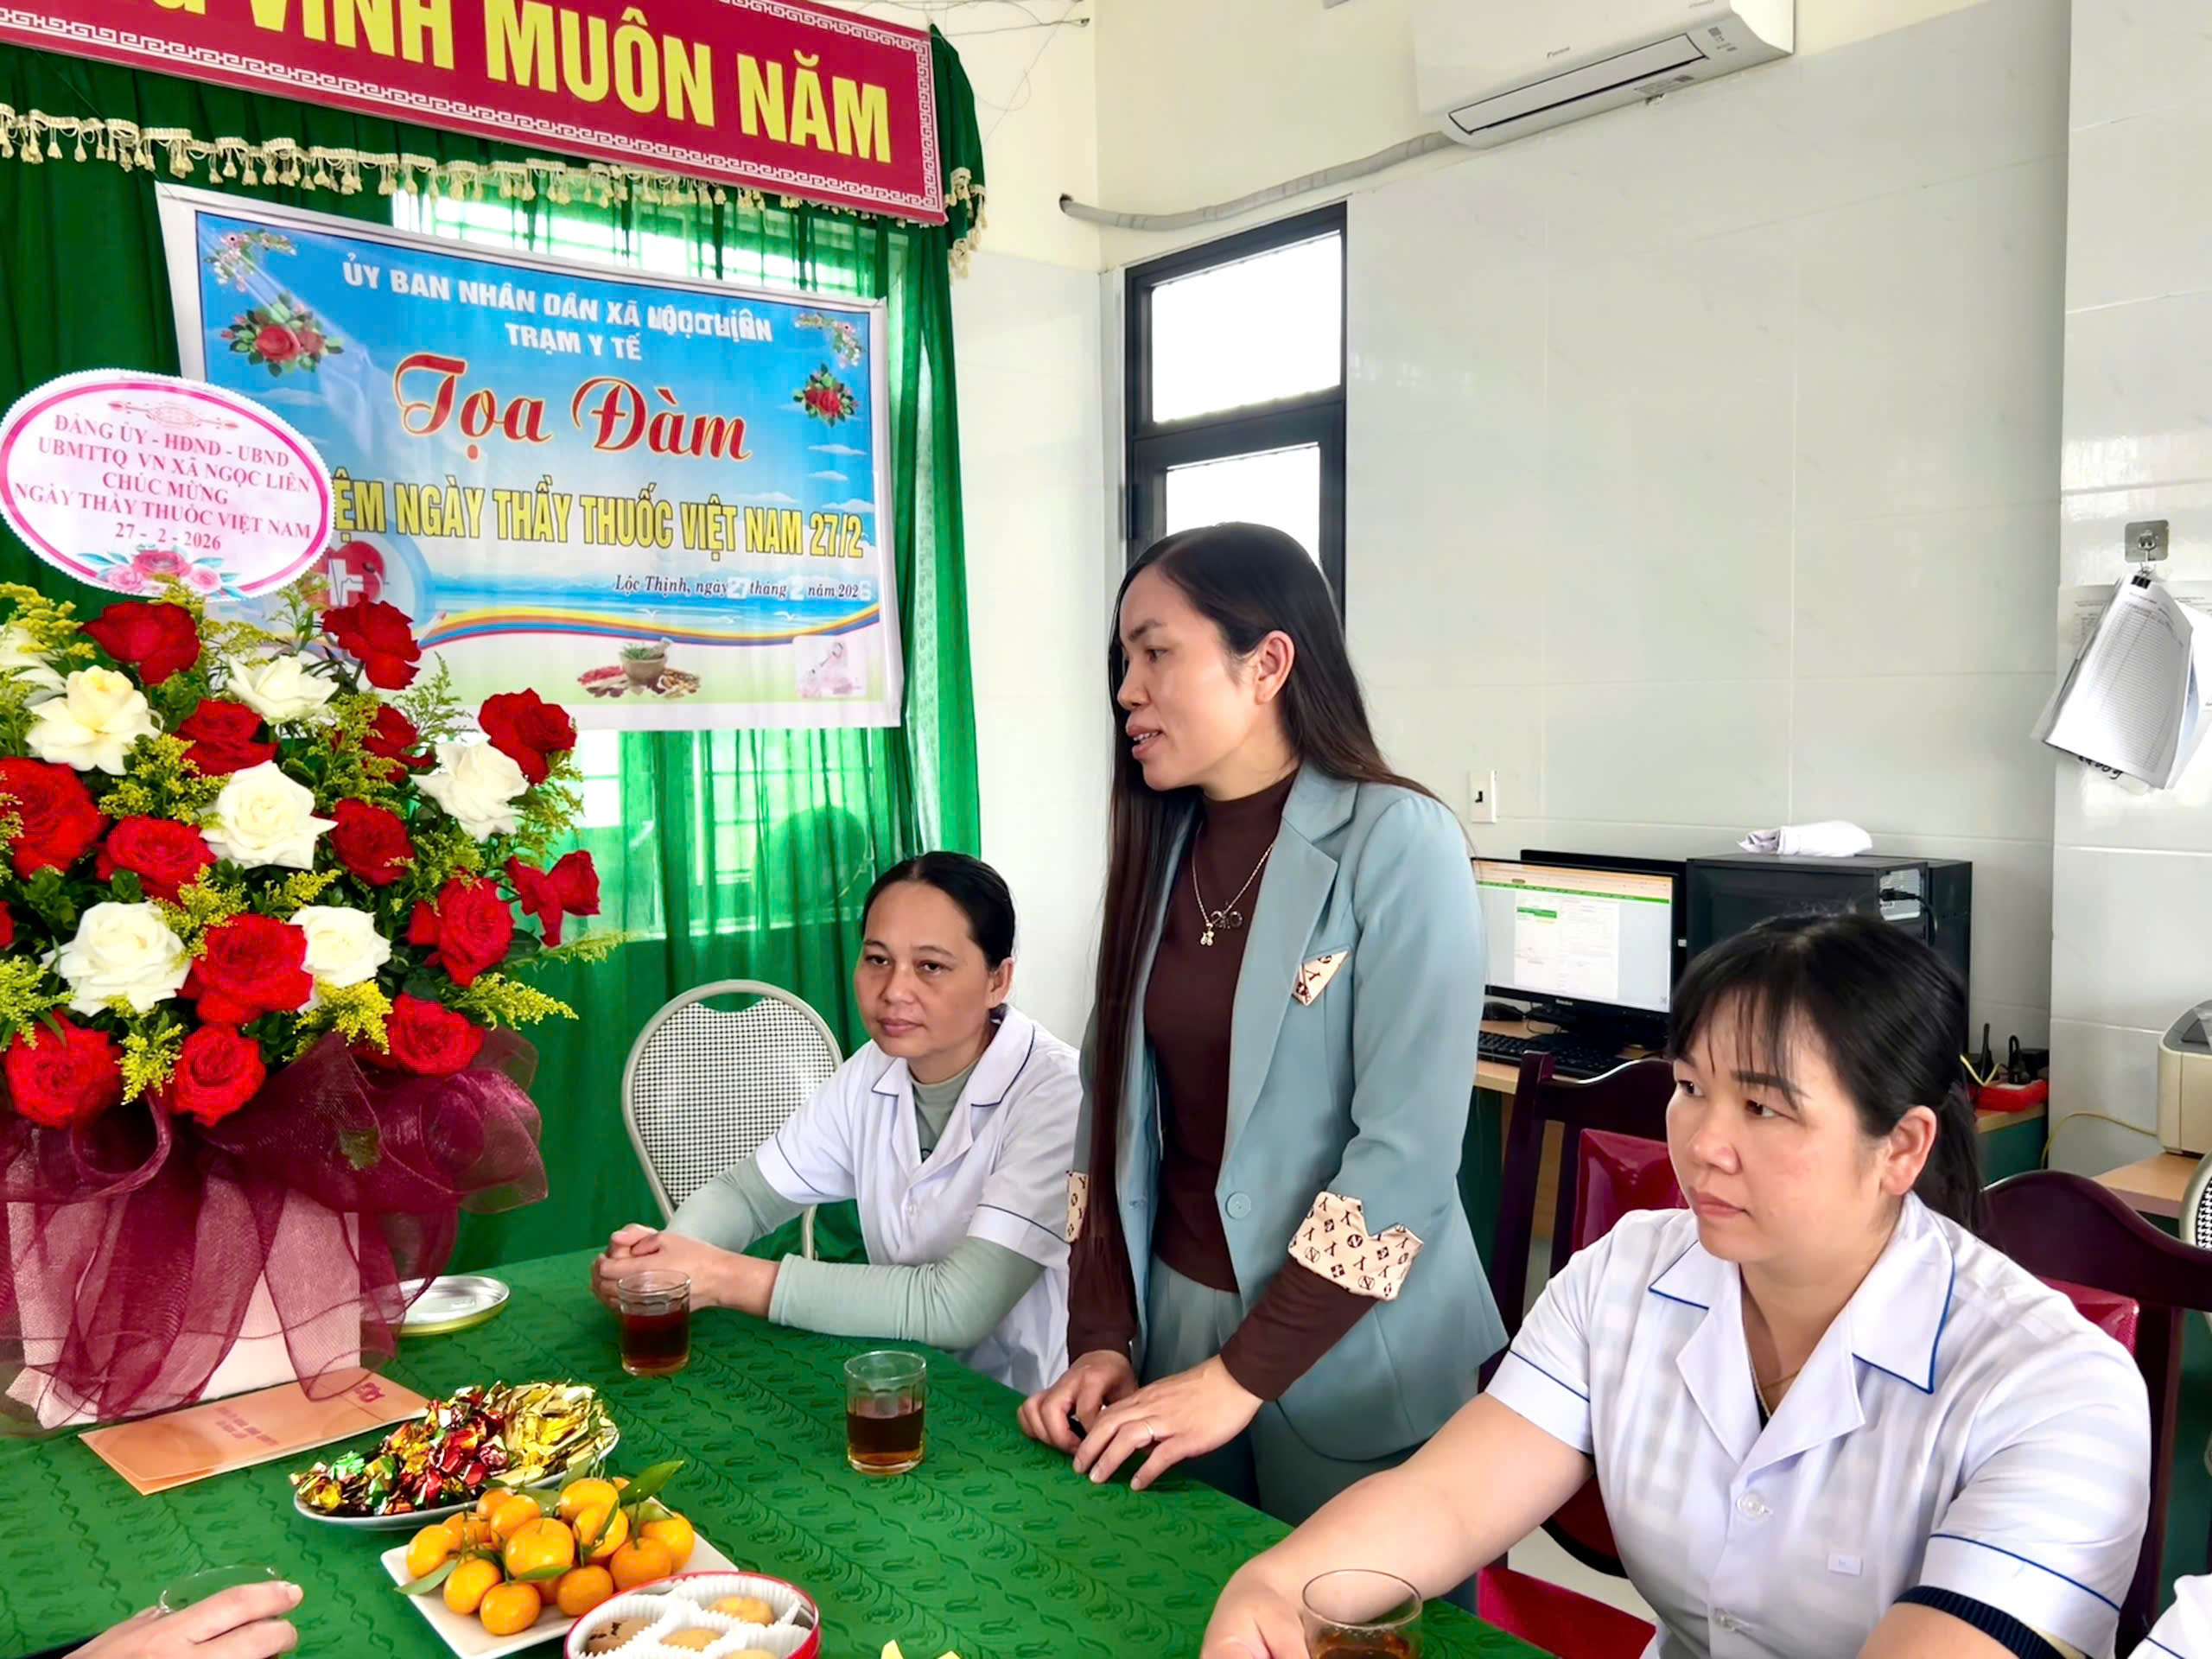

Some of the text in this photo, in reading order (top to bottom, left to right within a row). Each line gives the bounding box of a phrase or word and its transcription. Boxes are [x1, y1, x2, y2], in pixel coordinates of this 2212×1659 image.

[485, 0, 715, 128] MUÔN
[737, 49, 891, 164] NĂM
[343, 251, 380, 289] ỦY
[390, 270, 450, 301] BAN
[458, 280, 536, 314] NHÂN
[543, 292, 598, 322] DÂN
[607, 300, 641, 327] XÃ
[505, 322, 642, 360] TRẠM Y TẾ
[394, 353, 753, 462] Tọa Đàm
[38, 436, 310, 493] UBMTTQ VN XÃ NGỌC LIÊN
[164, 433, 221, 456] HĐND
[238, 445, 289, 467] UBND
[103, 472, 162, 496] CHÚC
[115, 522, 135, 538] 27
[158, 528, 166, 543] 2
[184, 531, 221, 551] 2026
[268, 519, 311, 539] NAM
[394, 474, 485, 539] NGÀY
[493, 474, 572, 543] THẦY
[580, 482, 673, 549] THUỐC
[679, 493, 738, 562] VIỆT
[744, 506, 804, 556] NAM
[810, 511, 863, 558] 27/2
